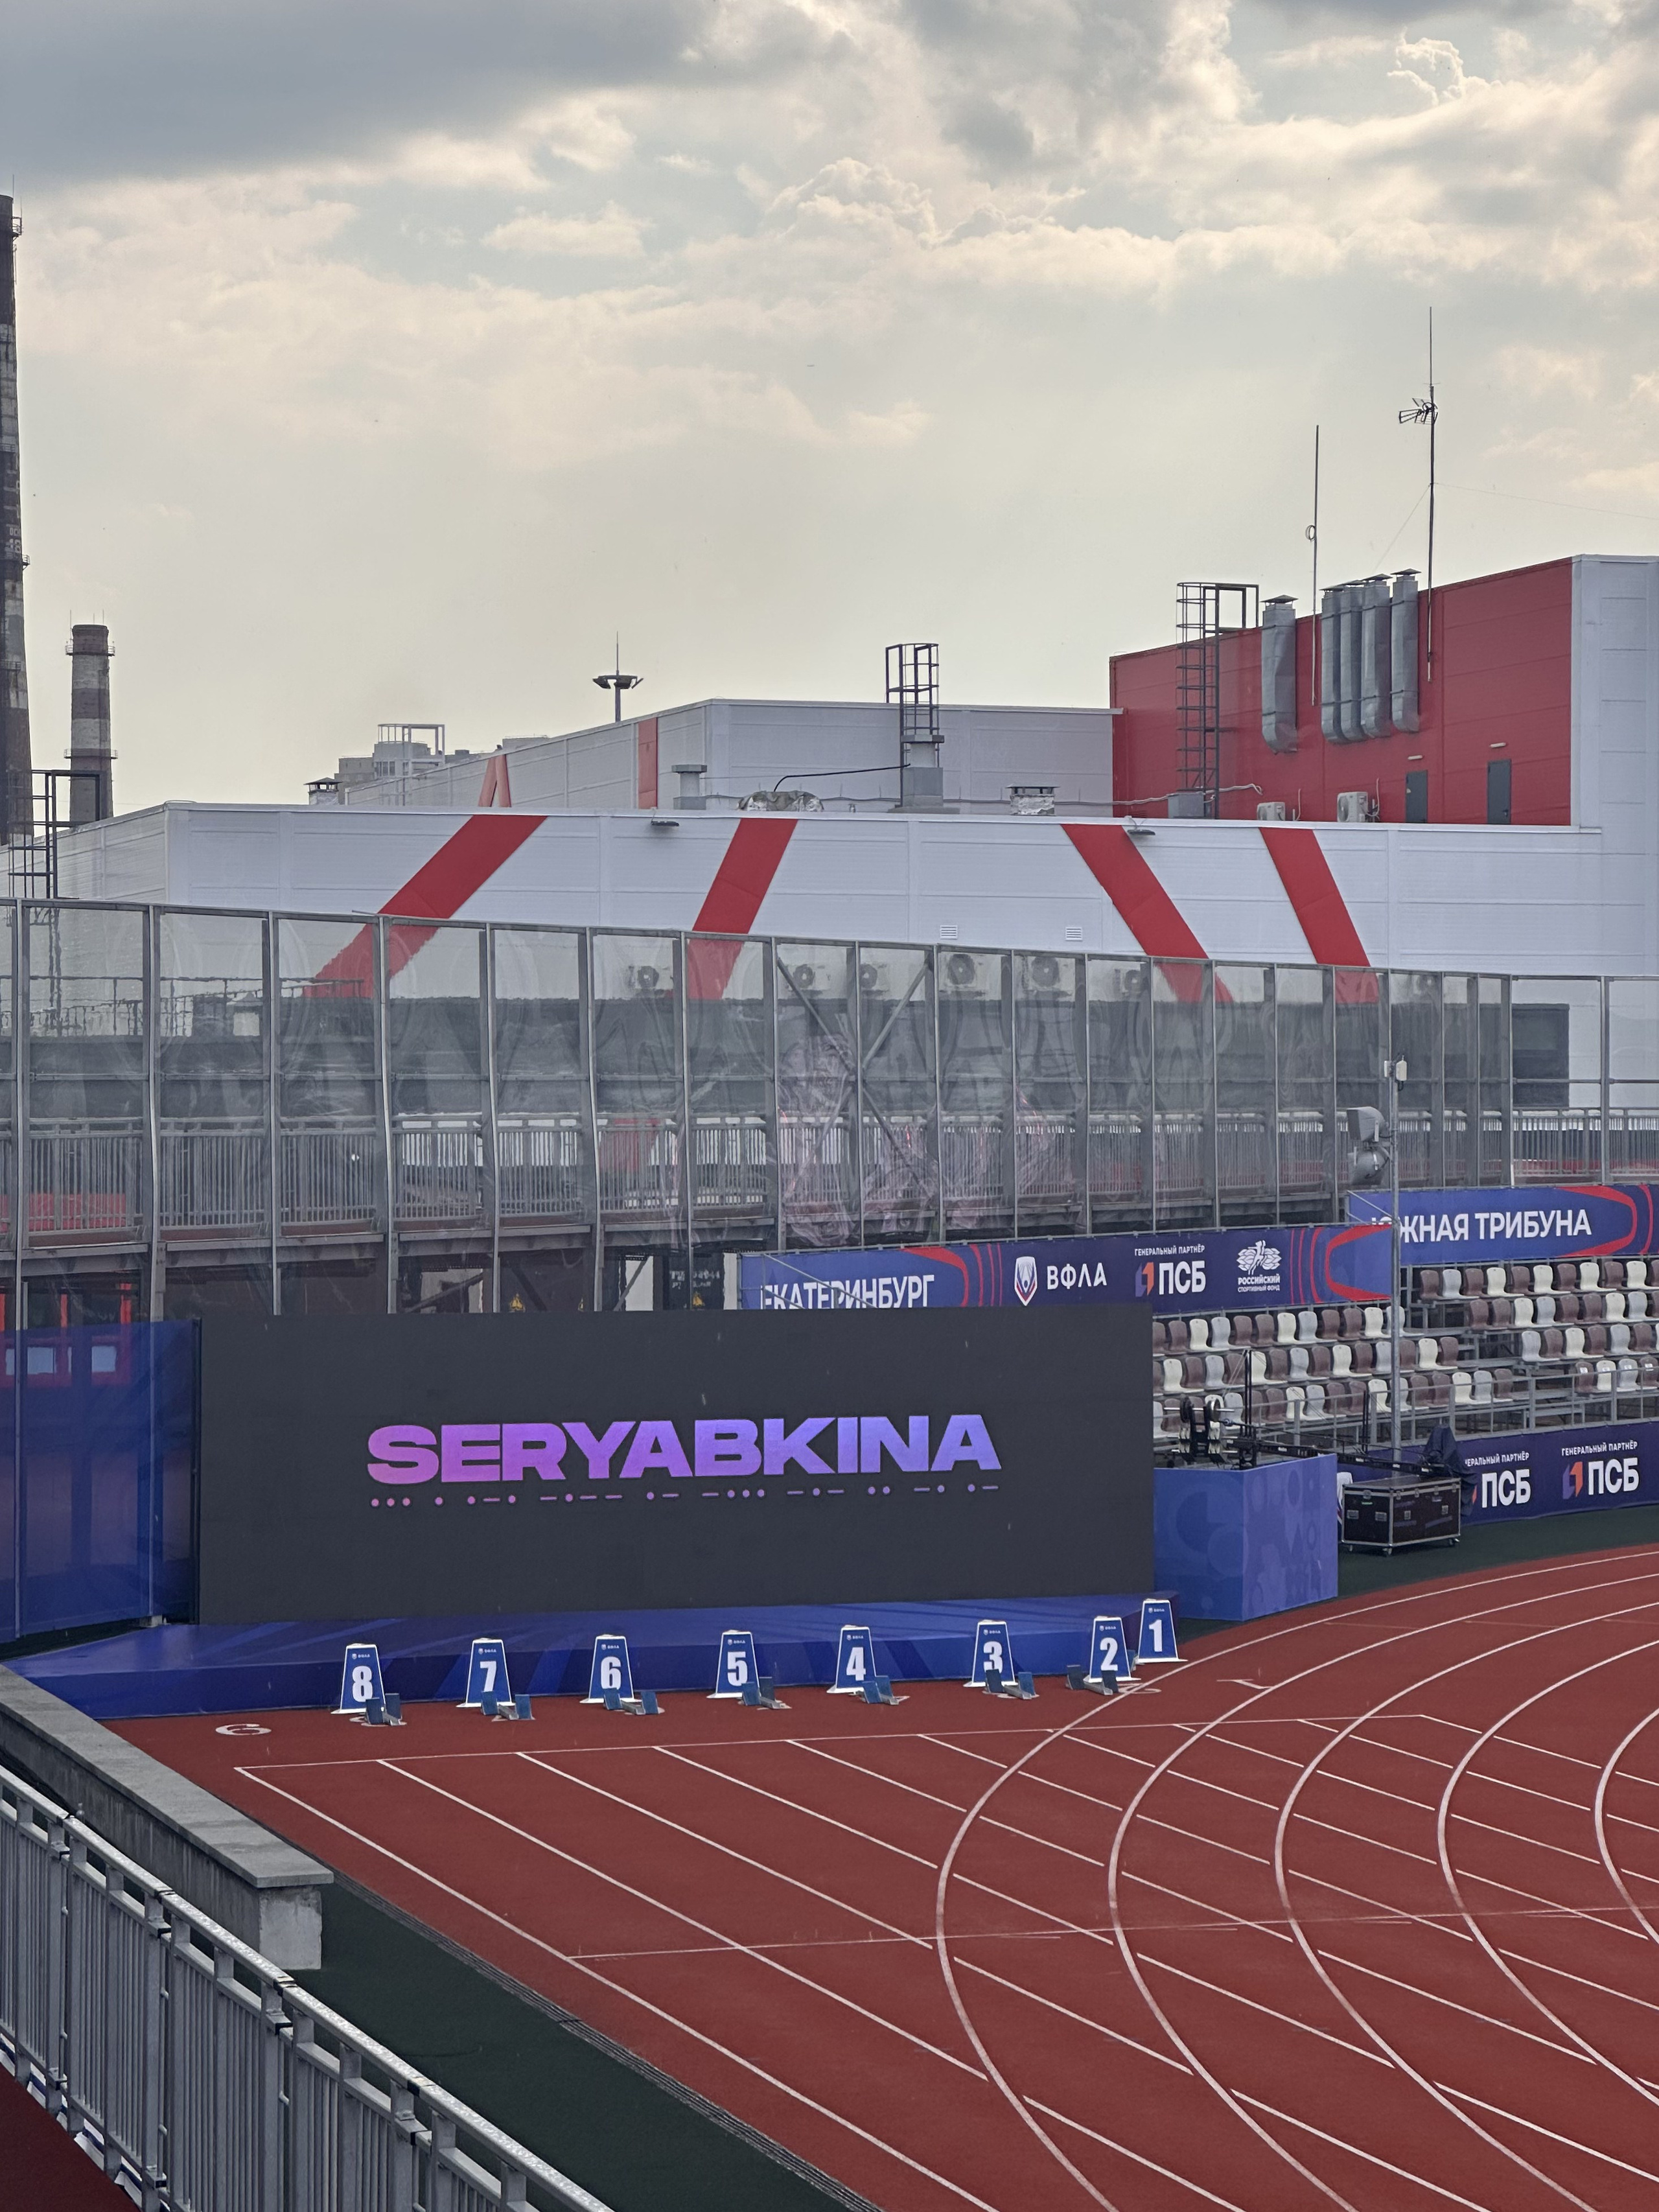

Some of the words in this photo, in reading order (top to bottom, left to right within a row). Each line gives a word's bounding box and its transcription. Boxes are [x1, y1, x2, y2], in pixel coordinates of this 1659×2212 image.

[1371, 1213, 1469, 1243] ЖНАЯ
[1474, 1209, 1592, 1240] ТРИБУНА
[1134, 1245, 1177, 1256] ГЕНЕРАЛЬНЫЙ
[1178, 1244, 1205, 1255] ПАРТНЁР
[1047, 1263, 1108, 1290] ВФЛА
[1159, 1261, 1207, 1295] ПСБ
[1238, 1274, 1281, 1285] РОССИЙСКИЙ
[367, 1414, 1002, 1485] SERYABKINA
[1465, 1453, 1500, 1467] ЕРАЛЬНЫЙ
[1501, 1451, 1530, 1463] ПАРТНЁР
[1562, 1442, 1607, 1456] ГЕНЕРАЛЬНЫЙ
[1608, 1439, 1638, 1452] ПАРТНЁР
[1481, 1469, 1531, 1509] ПСБ
[1588, 1457, 1640, 1495] ПСБ
[1148, 1619, 1163, 1652] 1
[727, 1651, 748, 1687] 5
[846, 1647, 866, 1681] 4
[983, 1641, 1003, 1674] 3
[1100, 1637, 1119, 1671] 2
[352, 1665, 373, 1703] 8
[480, 1660, 497, 1693] 7
[600, 1656, 621, 1690] 6
